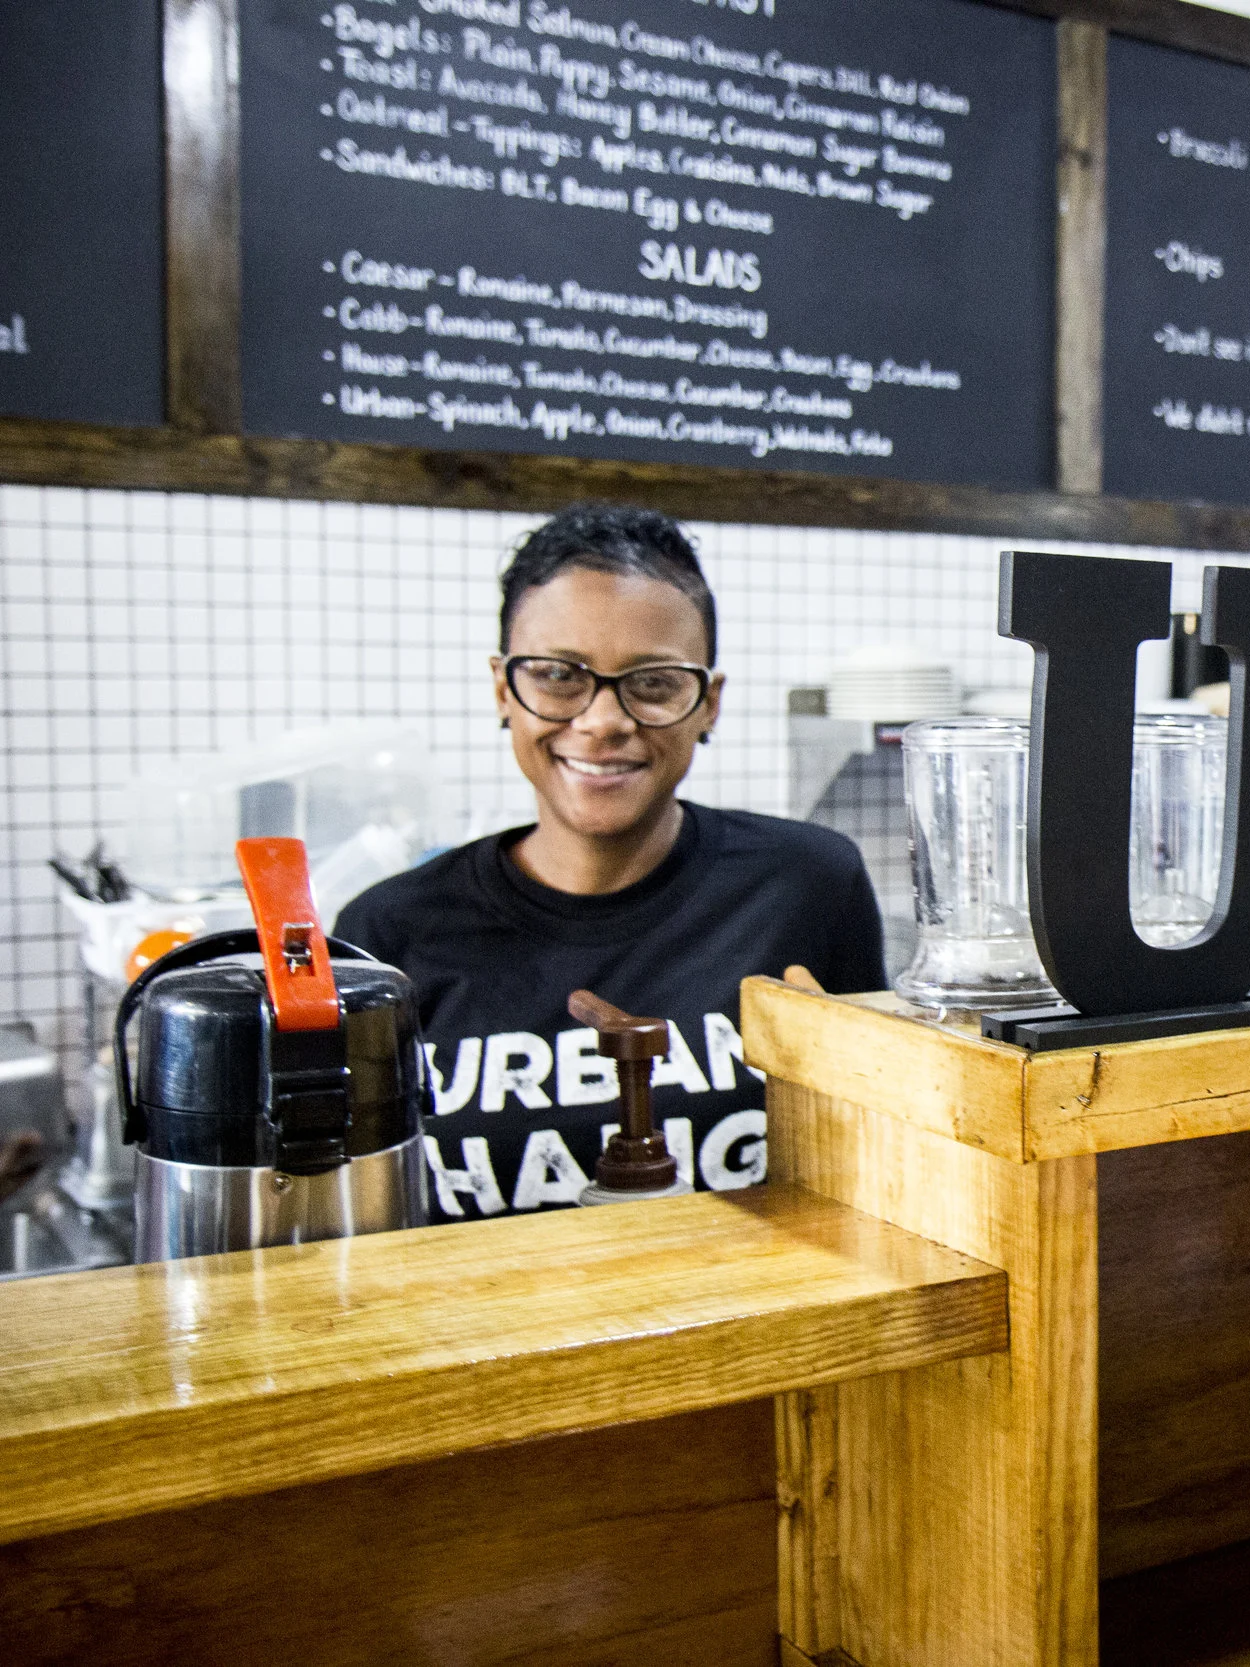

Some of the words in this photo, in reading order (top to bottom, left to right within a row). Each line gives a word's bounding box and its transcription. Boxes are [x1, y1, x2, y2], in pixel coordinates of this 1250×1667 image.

[633, 186, 679, 231] Egg
[341, 250, 435, 291] Caesar
[638, 239, 761, 293] SALADS
